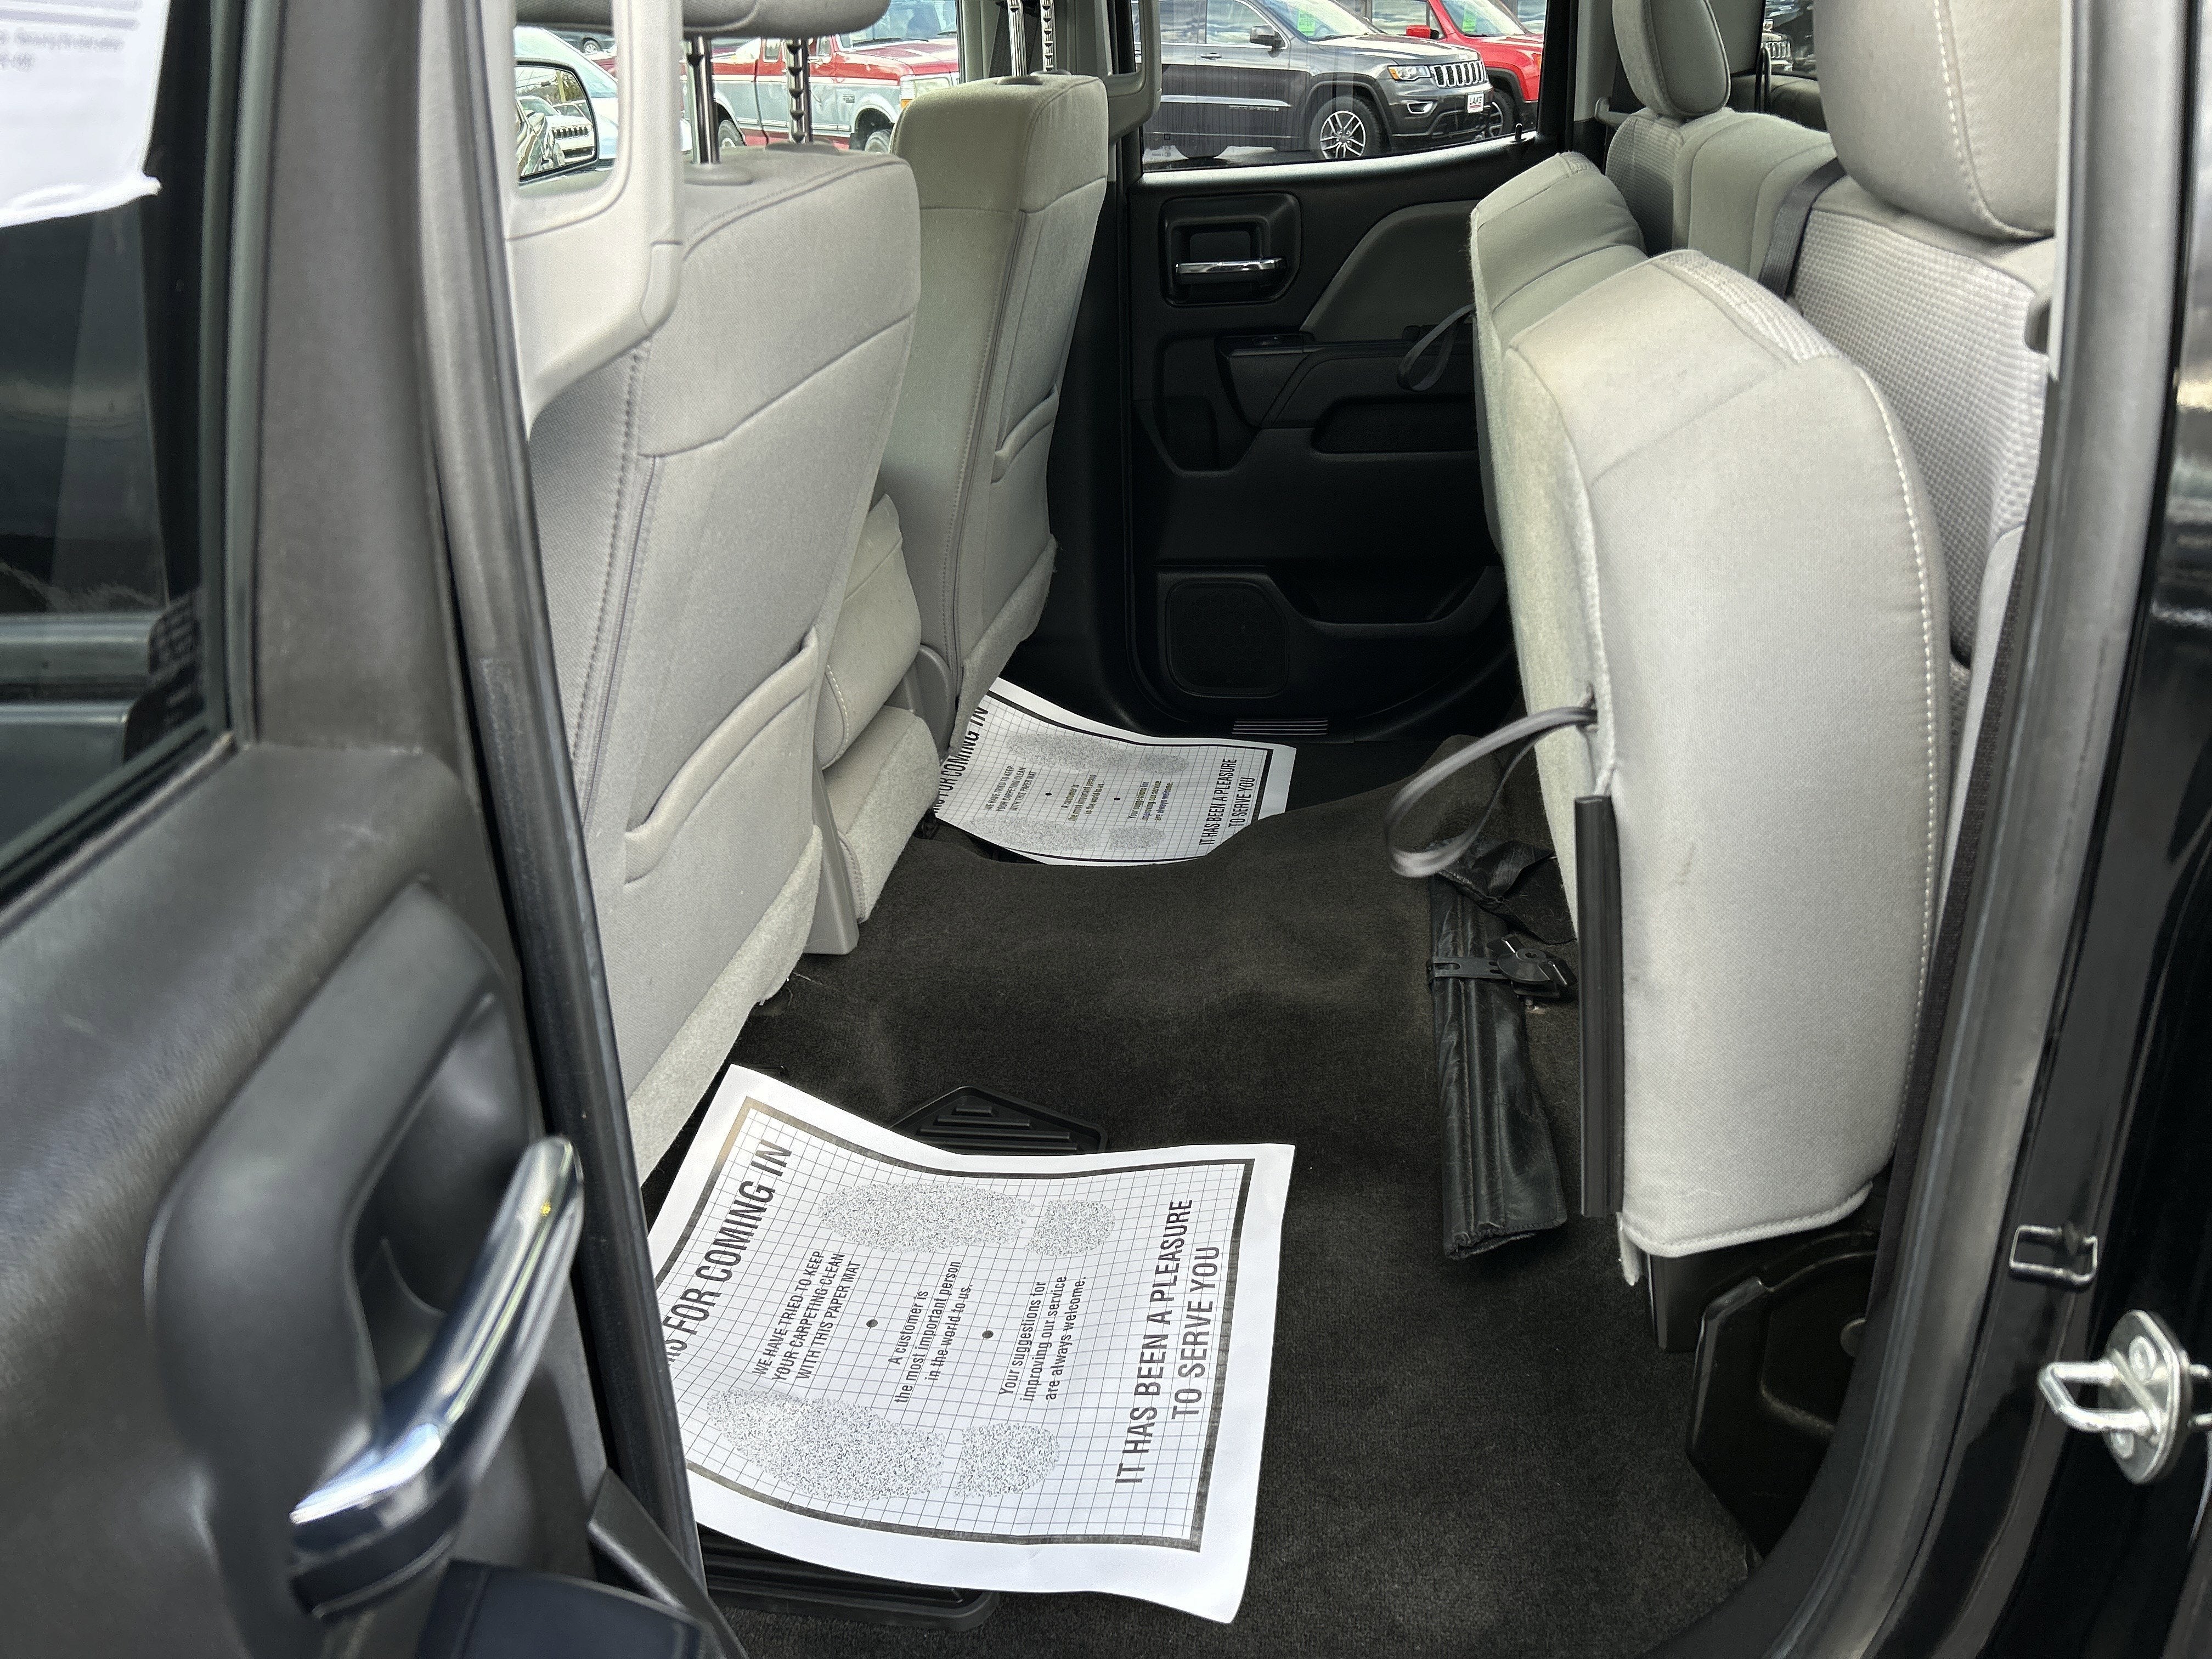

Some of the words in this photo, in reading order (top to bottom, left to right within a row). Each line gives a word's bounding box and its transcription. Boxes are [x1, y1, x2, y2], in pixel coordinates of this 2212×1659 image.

[969, 707, 988, 726] IN
[1214, 759, 1237, 794] PLEASURE
[1238, 777, 1255, 792] YOU
[1206, 803, 1226, 821] BEEN
[1232, 794, 1251, 816] SERVE
[1201, 823, 1220, 837] HAS
[1228, 818, 1245, 827] TO
[663, 1288, 722, 1335] FOR
[695, 1181, 775, 1282] COMING
[751, 1139, 792, 1176] IN
[1150, 1199, 1193, 1302] PLEASURE
[803, 1251, 824, 1276] KEEP
[939, 1261, 961, 1295] person
[1190, 1247, 1220, 1292] YOU
[795, 1279, 812, 1291] TO
[958, 1285, 973, 1299] us.
[772, 1351, 799, 1380] YOUR
[789, 1288, 828, 1347] CARPETING
[819, 1253, 845, 1285] CLEAN
[778, 1295, 804, 1325] TRIED
[951, 1303, 966, 1312] to
[1063, 1276, 1086, 1331] welcome.
[1147, 1310, 1172, 1325] A
[795, 1350, 821, 1379] WITH
[811, 1322, 833, 1346] THIS
[824, 1285, 850, 1318] PAPER
[842, 1261, 861, 1282] MAT
[895, 1303, 923, 1353] customer
[913, 1291, 928, 1300] is
[915, 1298, 947, 1350] important
[941, 1316, 961, 1345] world
[763, 1328, 788, 1357] HAVE
[999, 1369, 1020, 1395] Your
[1012, 1300, 1041, 1366] suggestions
[1031, 1282, 1046, 1296] for
[1020, 1342, 1052, 1401] improving
[1041, 1320, 1055, 1338] our
[1048, 1276, 1066, 1317] service
[1178, 1300, 1213, 1378] SERVE
[752, 1358, 772, 1375] WE
[906, 1353, 926, 1380] most
[930, 1350, 949, 1366] the
[1051, 1334, 1073, 1376] always
[1134, 1334, 1169, 1396] BEEN
[924, 1371, 941, 1380] in
[1046, 1380, 1060, 1400] are
[894, 1385, 913, 1403] the
[1171, 1388, 1202, 1420] TO
[1122, 1407, 1158, 1453] HAS
[1115, 1463, 1145, 1483] IT
